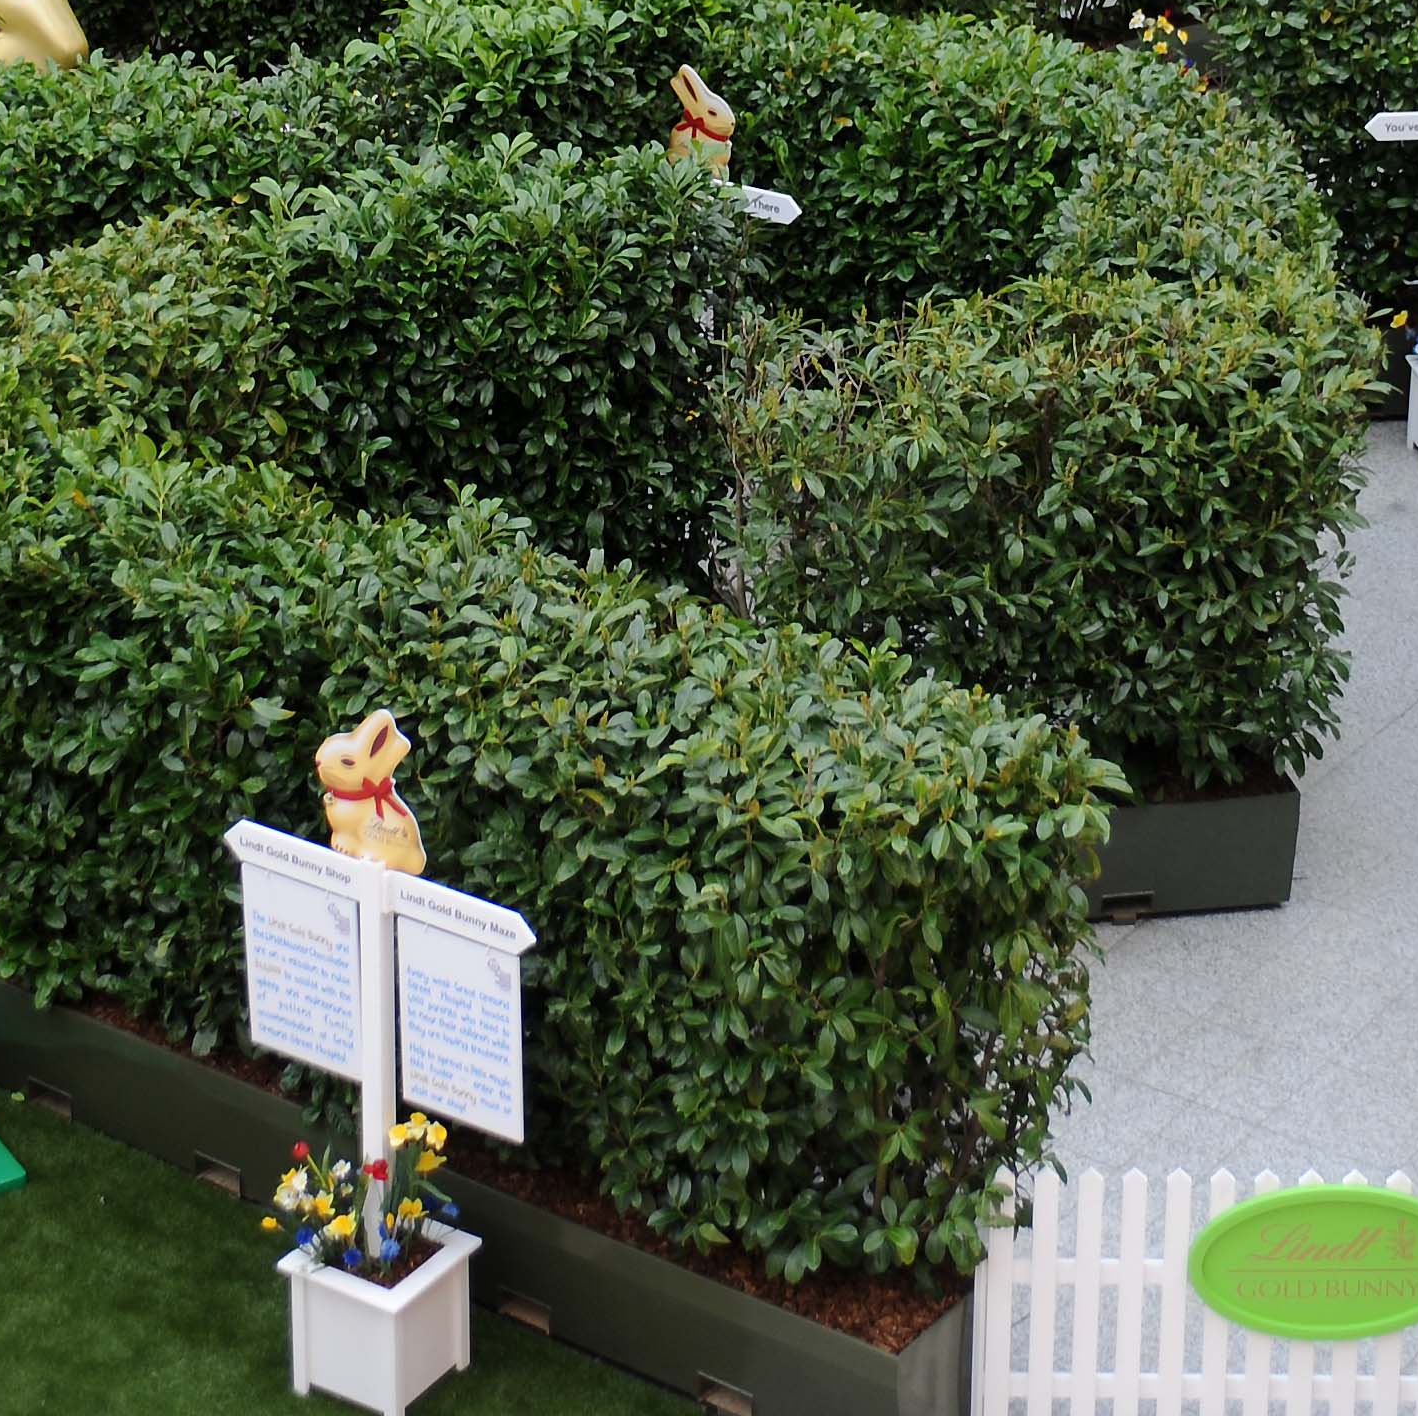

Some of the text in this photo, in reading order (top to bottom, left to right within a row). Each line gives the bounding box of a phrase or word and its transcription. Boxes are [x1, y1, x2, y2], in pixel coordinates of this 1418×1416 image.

[752, 198, 780, 214] There
[240, 835, 352, 884] Lindt Gold Bunny Shop
[400, 889, 517, 940] Lindt Gold Bunny Maze
[1246, 1223, 1383, 1263] Lindt
[1236, 1279, 1319, 1298] GOLD
